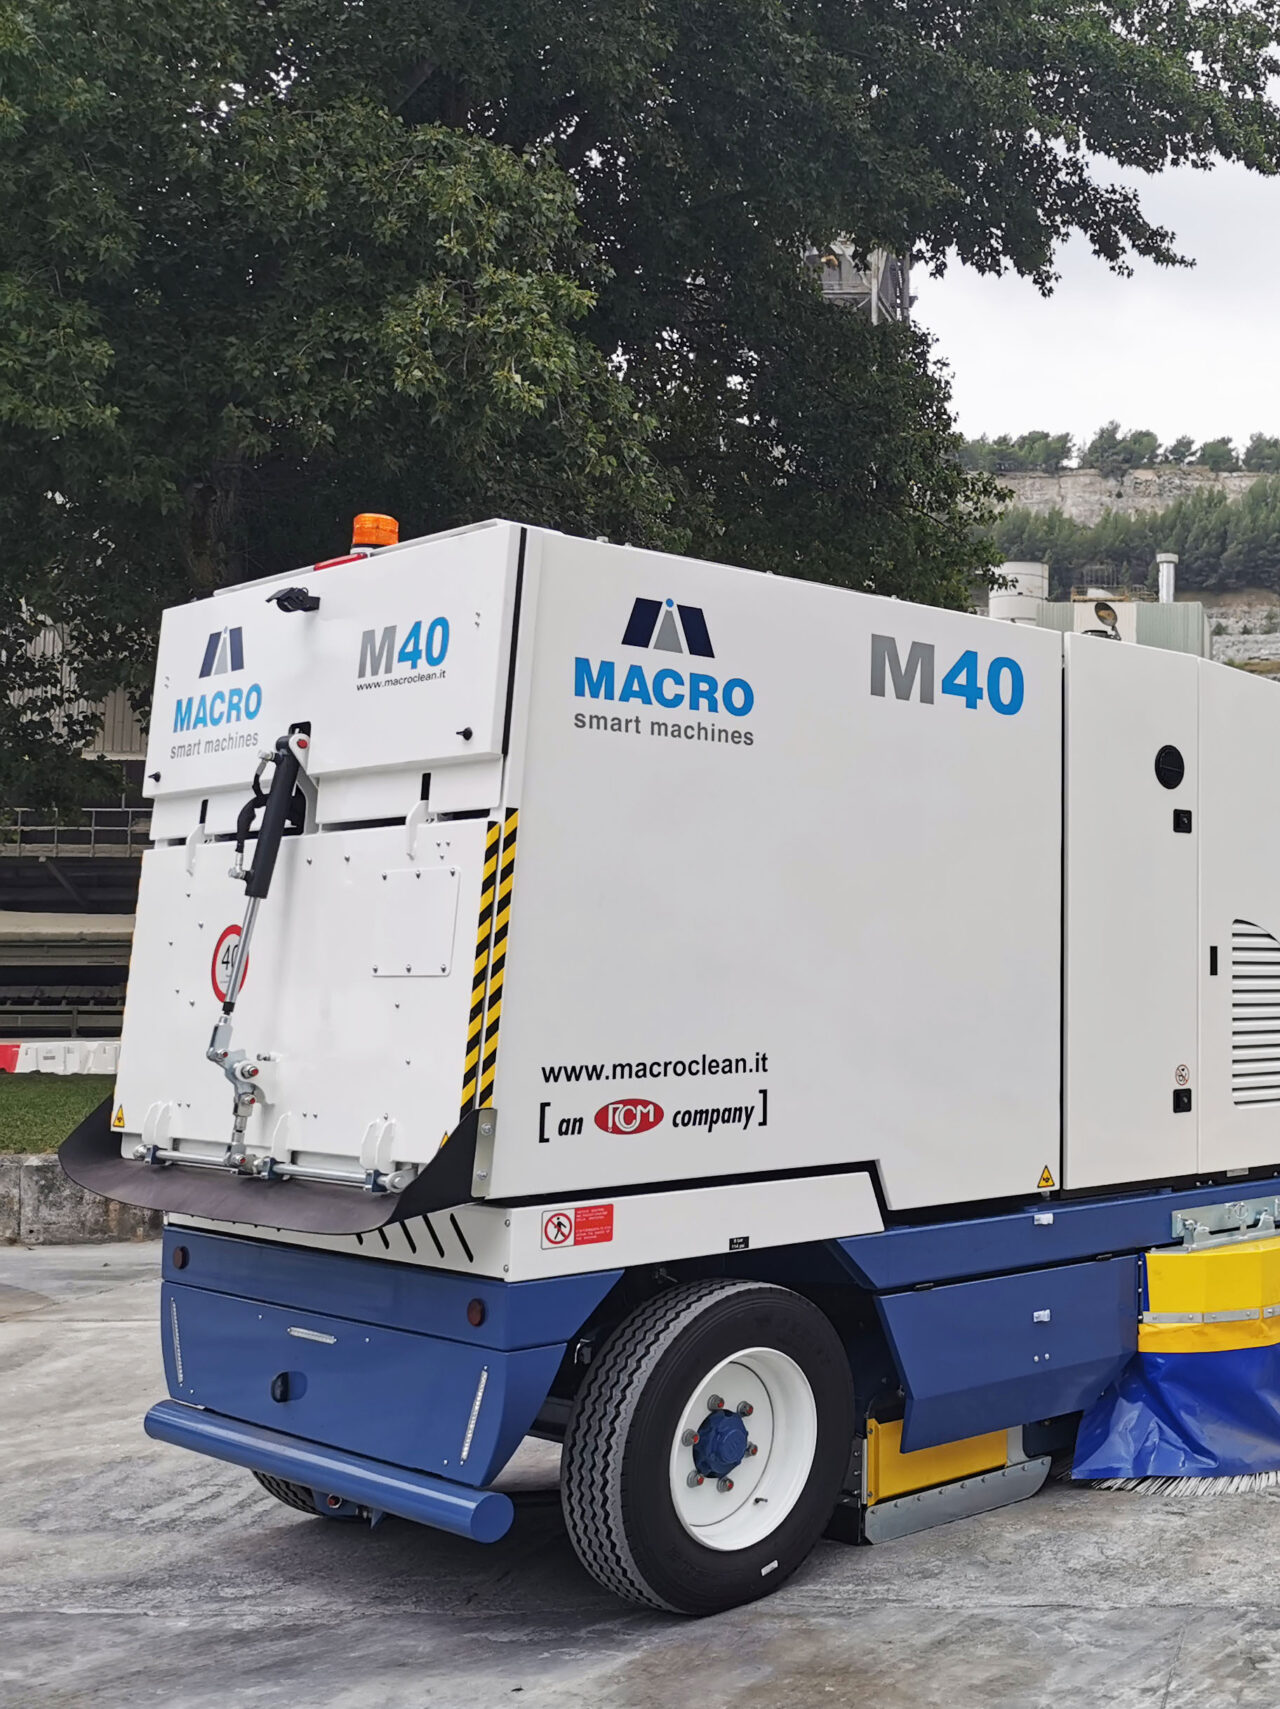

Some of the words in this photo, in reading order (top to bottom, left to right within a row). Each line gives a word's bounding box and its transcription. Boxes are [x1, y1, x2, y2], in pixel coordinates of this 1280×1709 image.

[357, 616, 450, 679] M40
[356, 669, 446, 691] www.macroclean.it
[573, 656, 755, 717] MACRO
[870, 633, 1025, 716] M40
[172, 683, 263, 733] MACRO
[573, 712, 641, 734] smart
[650, 720, 755, 746] machines
[169, 741, 201, 760] smart
[203, 731, 259, 755] machines
[541, 1052, 769, 1083] www.macroclean.it
